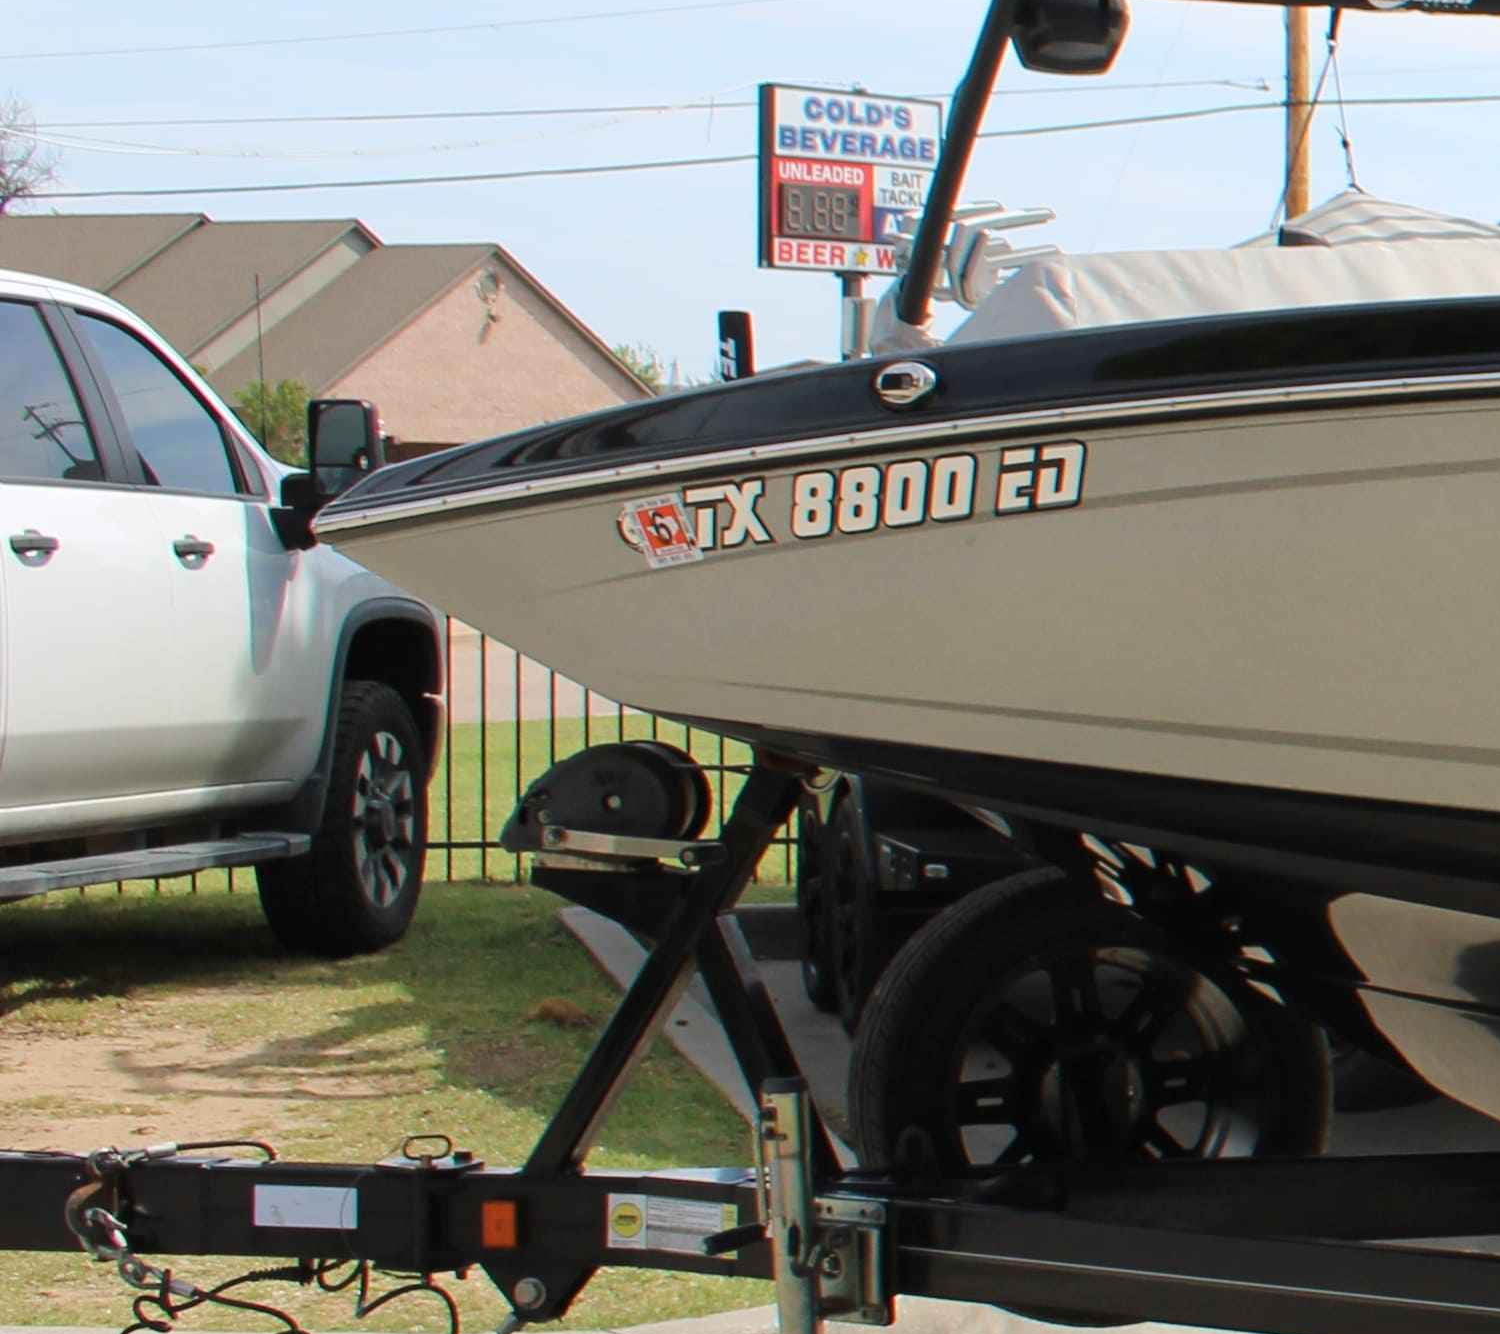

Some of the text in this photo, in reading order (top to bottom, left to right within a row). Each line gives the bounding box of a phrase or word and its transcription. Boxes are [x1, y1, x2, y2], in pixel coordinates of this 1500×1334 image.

[803, 97, 912, 130] COLD'S
[778, 125, 935, 162] BEVERAGE
[778, 161, 865, 185] UNLEADED
[890, 171, 923, 188] BAIT
[778, 242, 846, 266] BEER
[682, 476, 775, 550] TX
[791, 453, 977, 538] 8800
